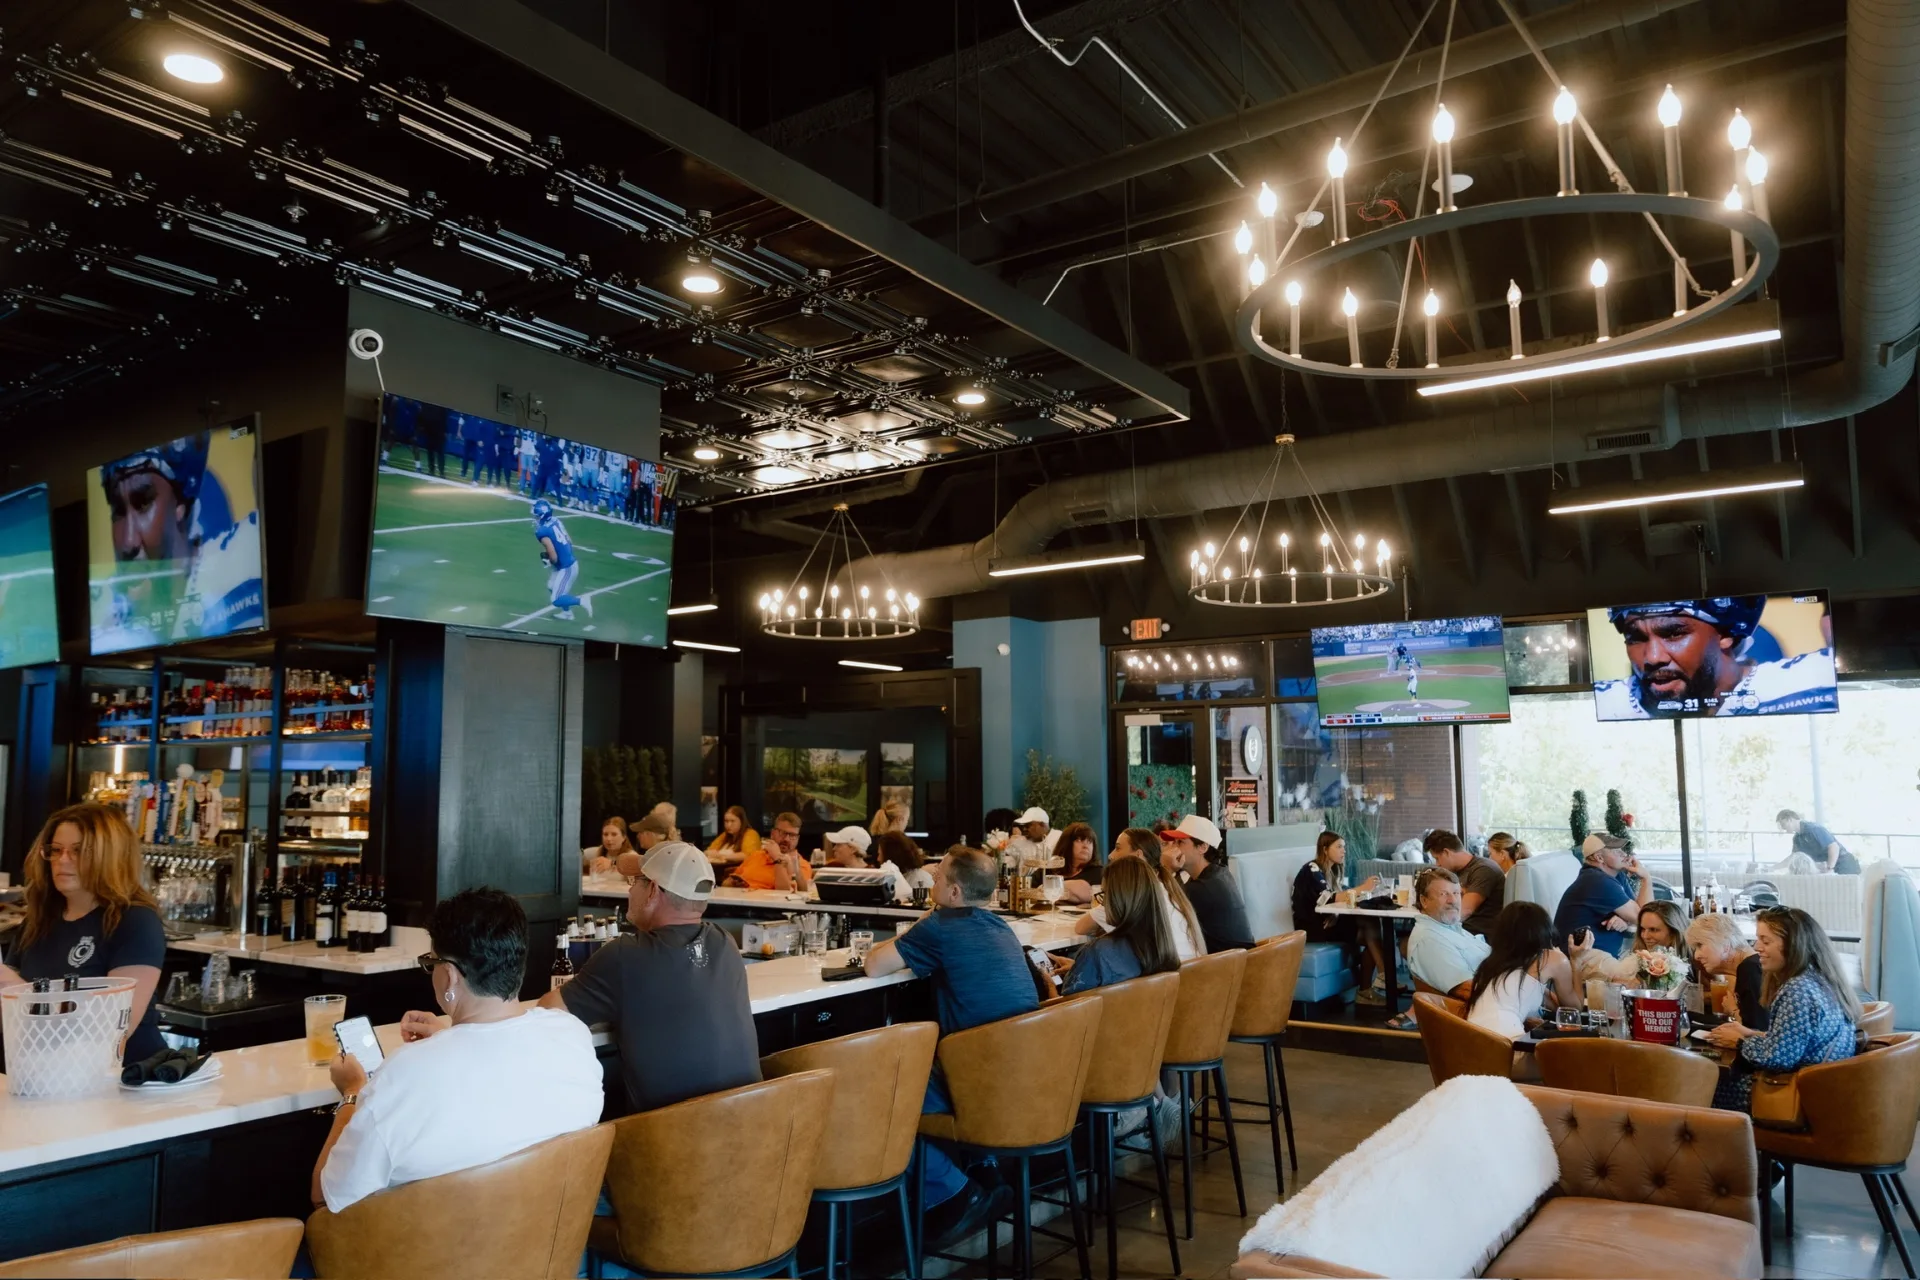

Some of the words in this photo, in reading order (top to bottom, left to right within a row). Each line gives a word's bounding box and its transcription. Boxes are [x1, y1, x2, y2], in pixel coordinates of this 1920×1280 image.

[586, 447, 598, 462] 97
[1136, 619, 1158, 638] EXIT
[1684, 698, 1699, 708] 31
[1759, 695, 1833, 714] SEAHAWKS
[1637, 1009, 1655, 1018] THIS
[1656, 1011, 1677, 1019] BUD'S
[1642, 1017, 1657, 1025] FOR
[1658, 1018, 1673, 1026] OUR
[1645, 1025, 1672, 1033] HEROES
